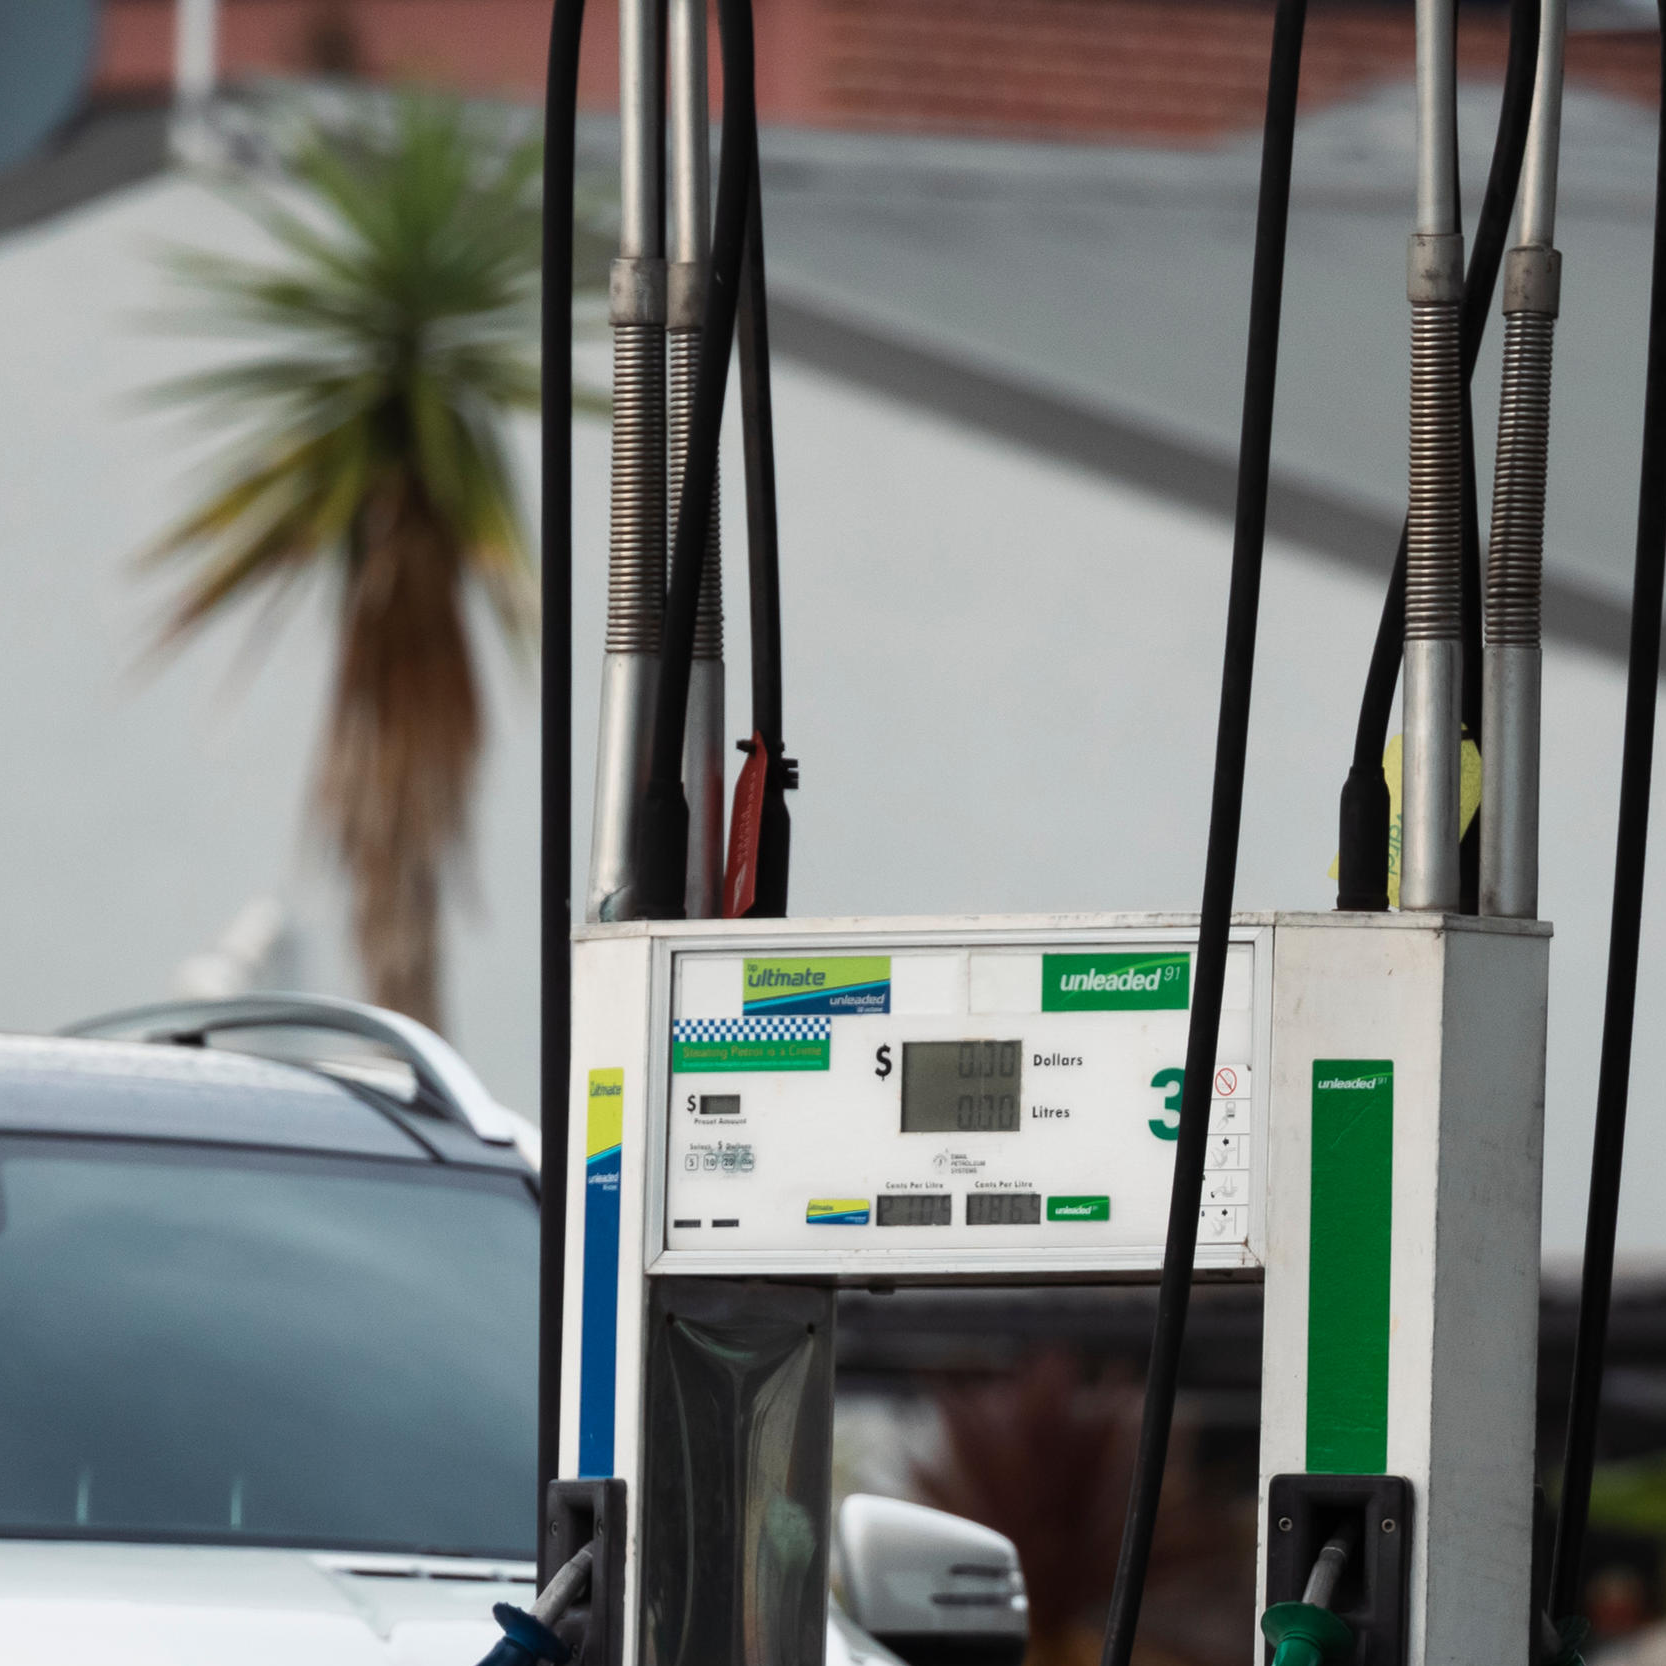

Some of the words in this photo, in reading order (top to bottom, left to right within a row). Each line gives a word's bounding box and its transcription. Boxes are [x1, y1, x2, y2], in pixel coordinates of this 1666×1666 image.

[747, 967, 826, 988] ultimate
[1059, 967, 1162, 992] unleaded
[1164, 965, 1181, 981] 91
[829, 993, 886, 1006] unleaded
[682, 1046, 728, 1060] Stealing
[731, 1045, 764, 1057] Petrol
[789, 1044, 822, 1056] Crime
[874, 1043, 892, 1081] $
[1032, 1053, 1084, 1067] Dollars
[1317, 1077, 1377, 1089] unleaded
[686, 1094, 697, 1113] $
[1148, 1067, 1185, 1141] 3
[1031, 1106, 1071, 1119] Litres
[885, 1181, 908, 1190] Cents
[909, 1181, 923, 1190] Per
[974, 1180, 997, 1189] Cents
[999, 1180, 1013, 1189] Per
[1055, 1204, 1093, 1216] unleaded
